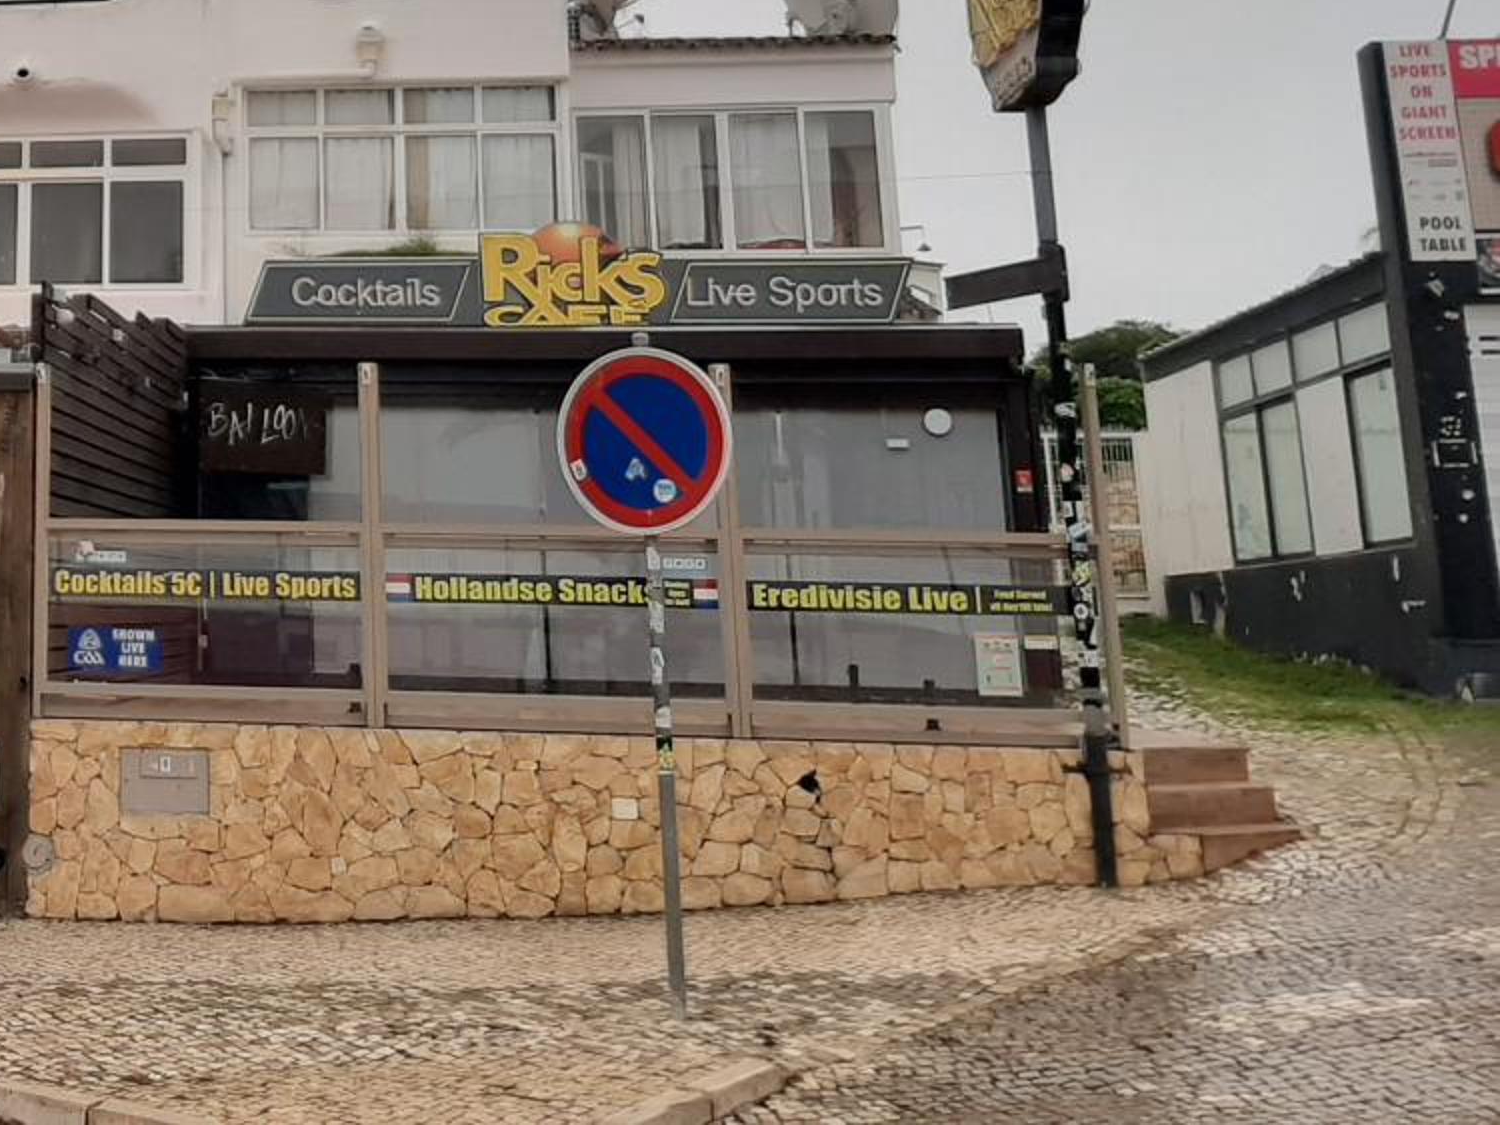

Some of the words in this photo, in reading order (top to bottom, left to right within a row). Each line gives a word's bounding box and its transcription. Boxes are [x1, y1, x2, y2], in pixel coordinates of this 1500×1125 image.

[1399, 44, 1430, 58] LIVE
[1389, 64, 1447, 78] SPORTS
[1411, 85, 1433, 98] ON
[1402, 106, 1447, 119] GIANT
[1399, 126, 1457, 141] SCREEN
[1419, 216, 1461, 231] POOL
[1420, 237, 1467, 253] TABLE
[291, 276, 441, 308] Cocktails
[687, 277, 757, 306] Live
[767, 278, 884, 311] Sports
[55, 569, 167, 595] Cocktails
[223, 572, 269, 597] Live
[276, 573, 357, 601] Sports
[415, 576, 553, 603] Hollandse
[752, 583, 901, 610] Eredivisie
[907, 586, 969, 612] Live
[121, 642, 145, 654] LIVE
